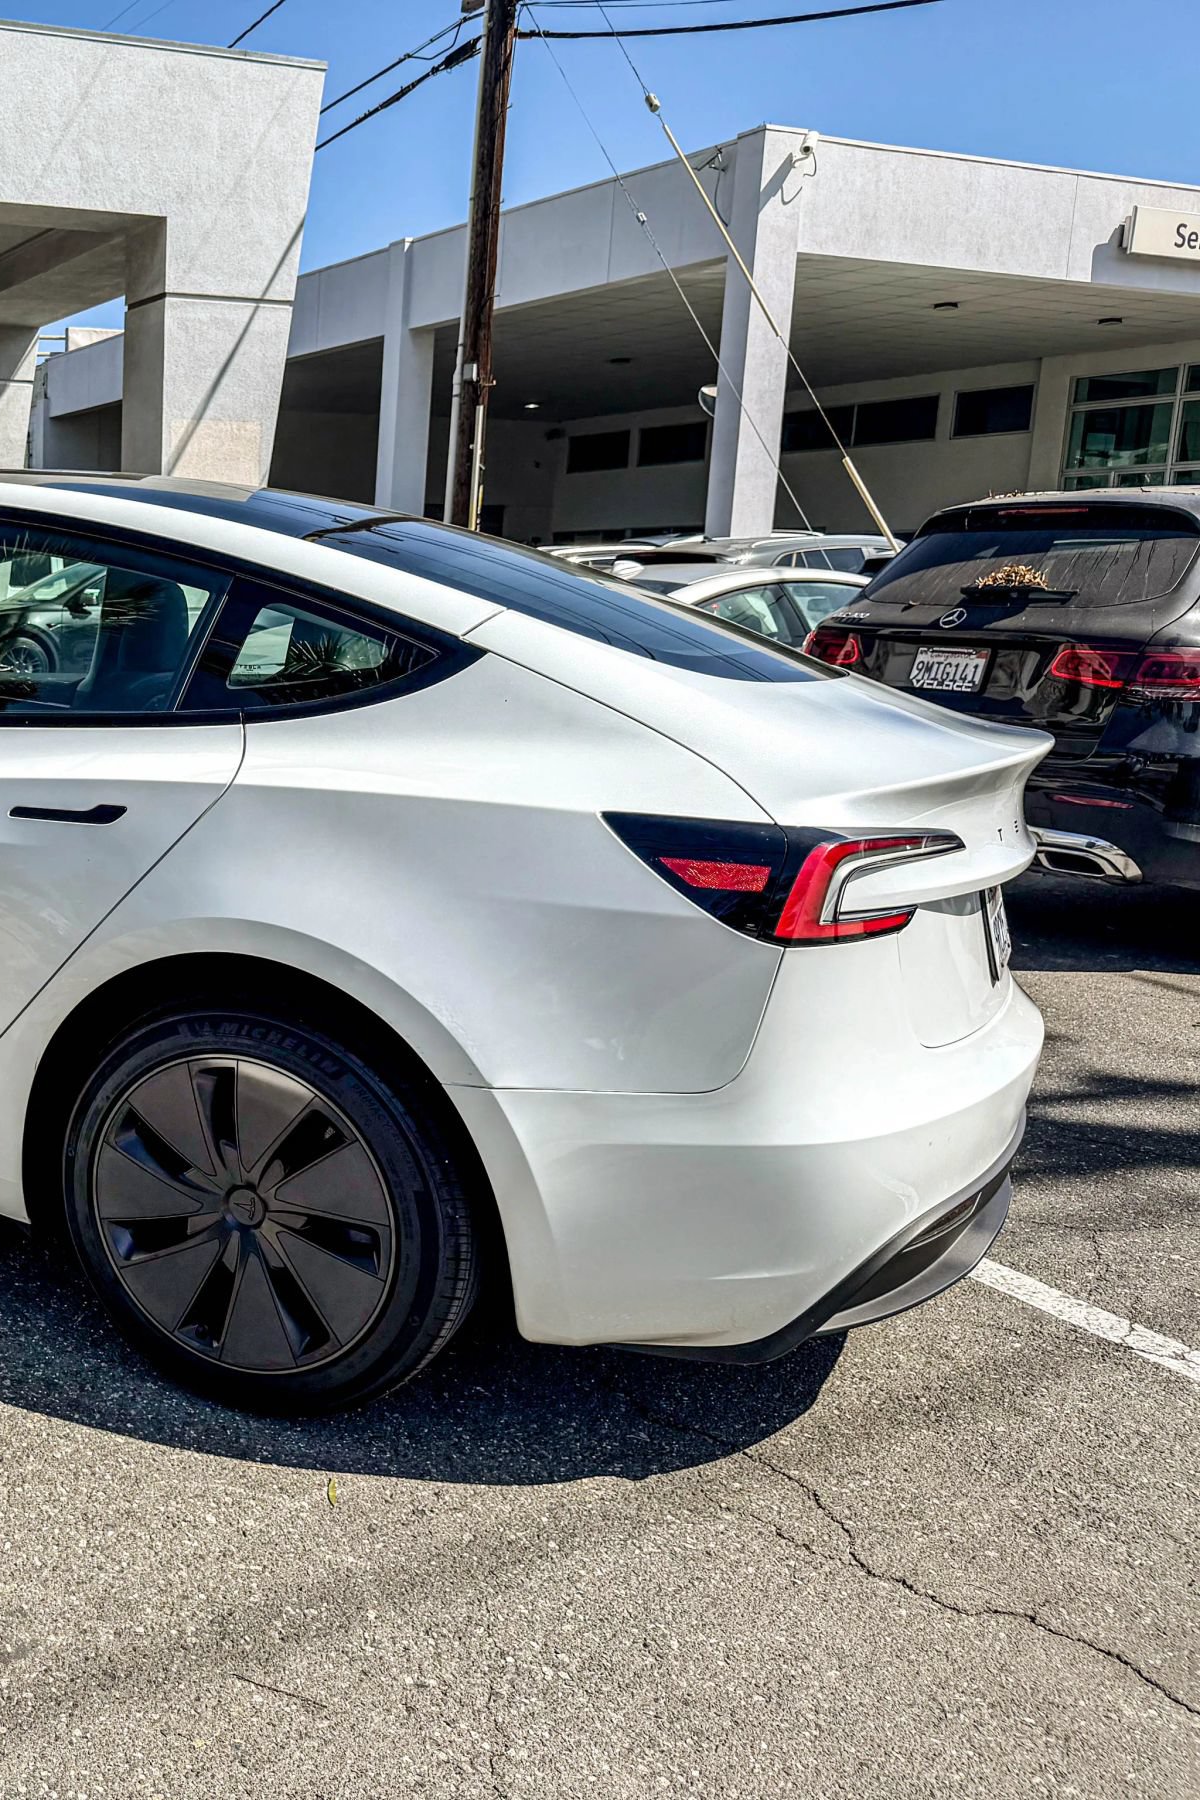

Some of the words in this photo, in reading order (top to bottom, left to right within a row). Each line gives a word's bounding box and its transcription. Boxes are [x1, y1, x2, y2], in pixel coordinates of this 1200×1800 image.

[1174, 222, 1200, 250] Se
[912, 660, 979, 683] 9MIG141
[216, 1021, 345, 1082] MICHELIN
